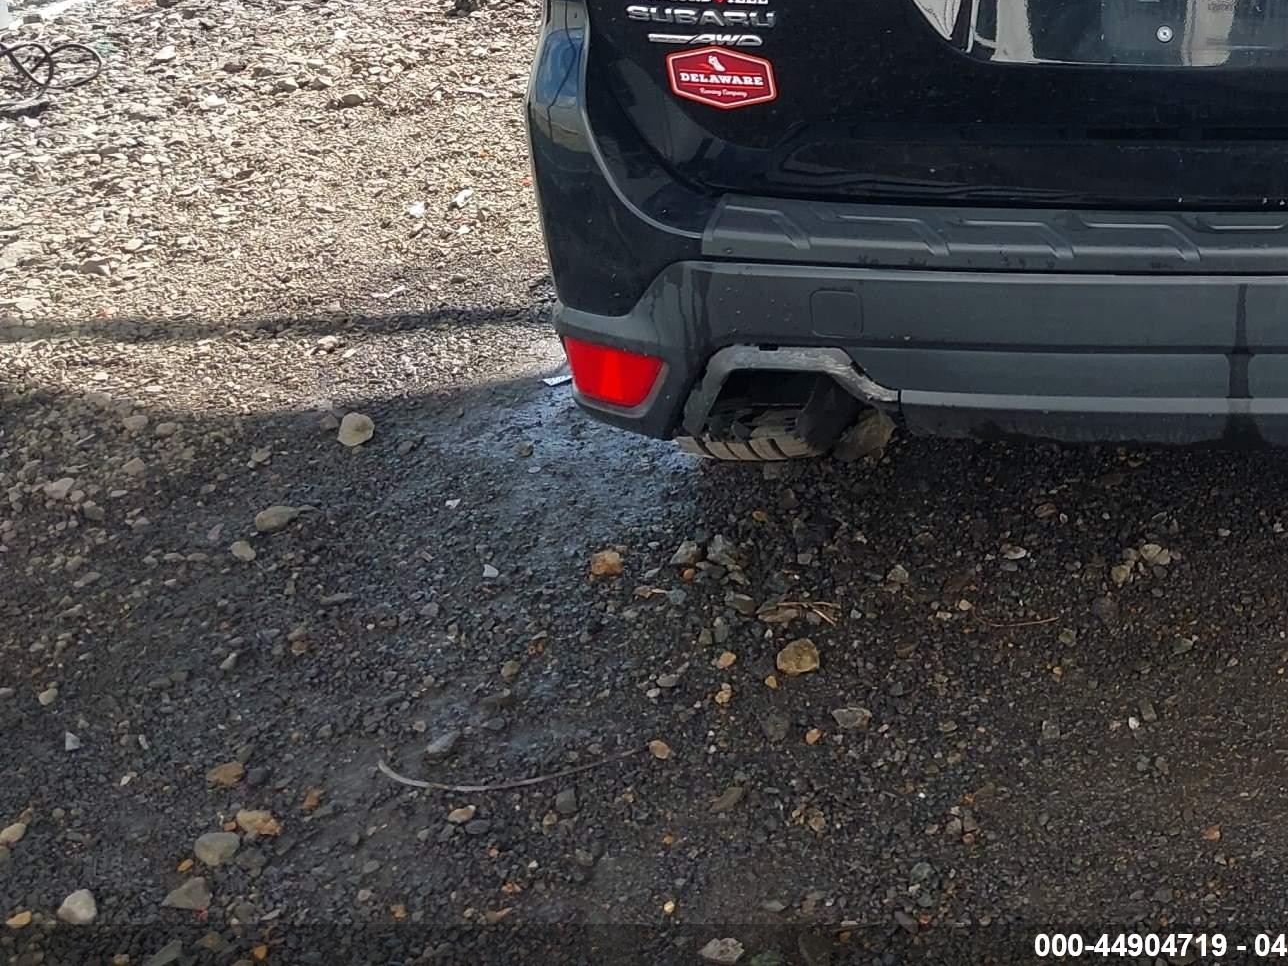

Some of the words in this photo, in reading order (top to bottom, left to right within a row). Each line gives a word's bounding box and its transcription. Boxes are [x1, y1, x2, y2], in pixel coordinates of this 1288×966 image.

[626, 5, 777, 28] SUBARU
[688, 33, 763, 46] AWD
[680, 72, 764, 86] DELAWARE
